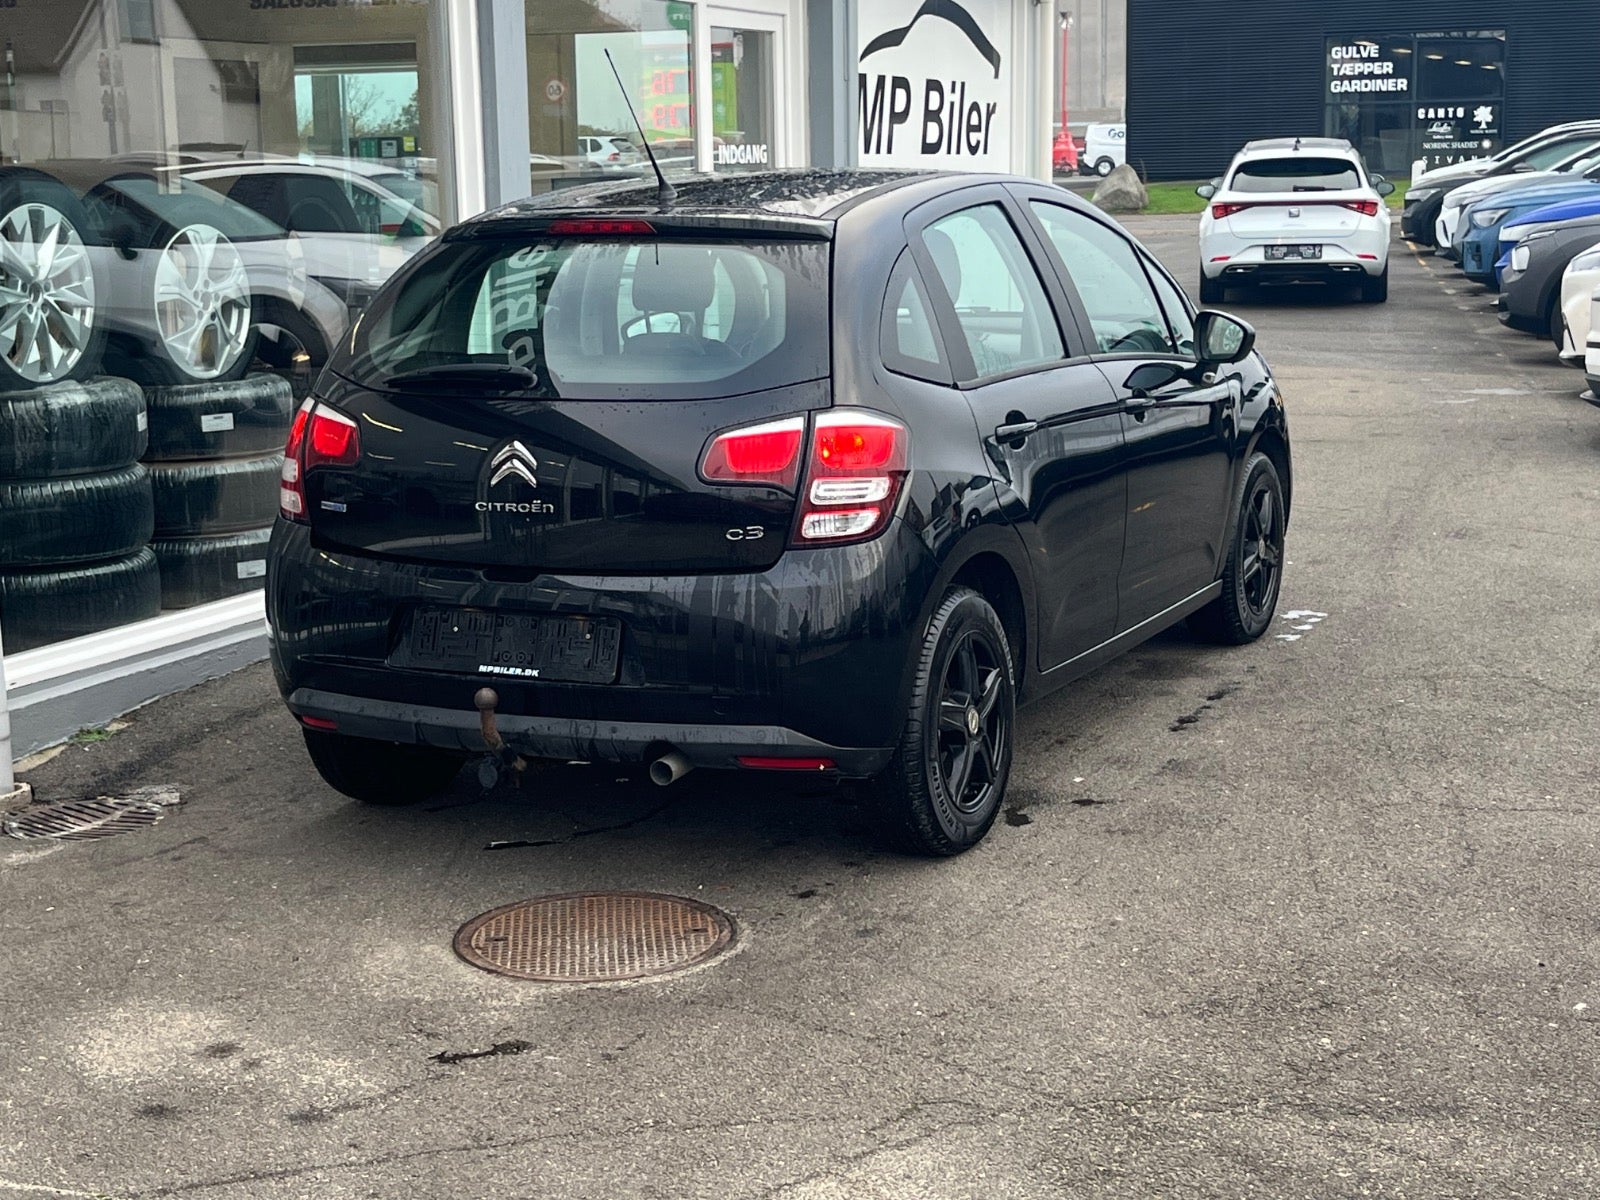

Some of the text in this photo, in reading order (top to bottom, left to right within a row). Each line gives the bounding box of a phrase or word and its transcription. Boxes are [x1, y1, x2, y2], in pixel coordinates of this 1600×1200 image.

[1331, 45, 1379, 59] GULVE
[1331, 61, 1394, 76] TÆPPER
[1330, 78, 1408, 93] GARDINER
[858, 73, 997, 156] MP Biler
[718, 144, 768, 165] INDGANG
[725, 525, 764, 541] C3
[478, 664, 540, 677] MPBILER.DK
